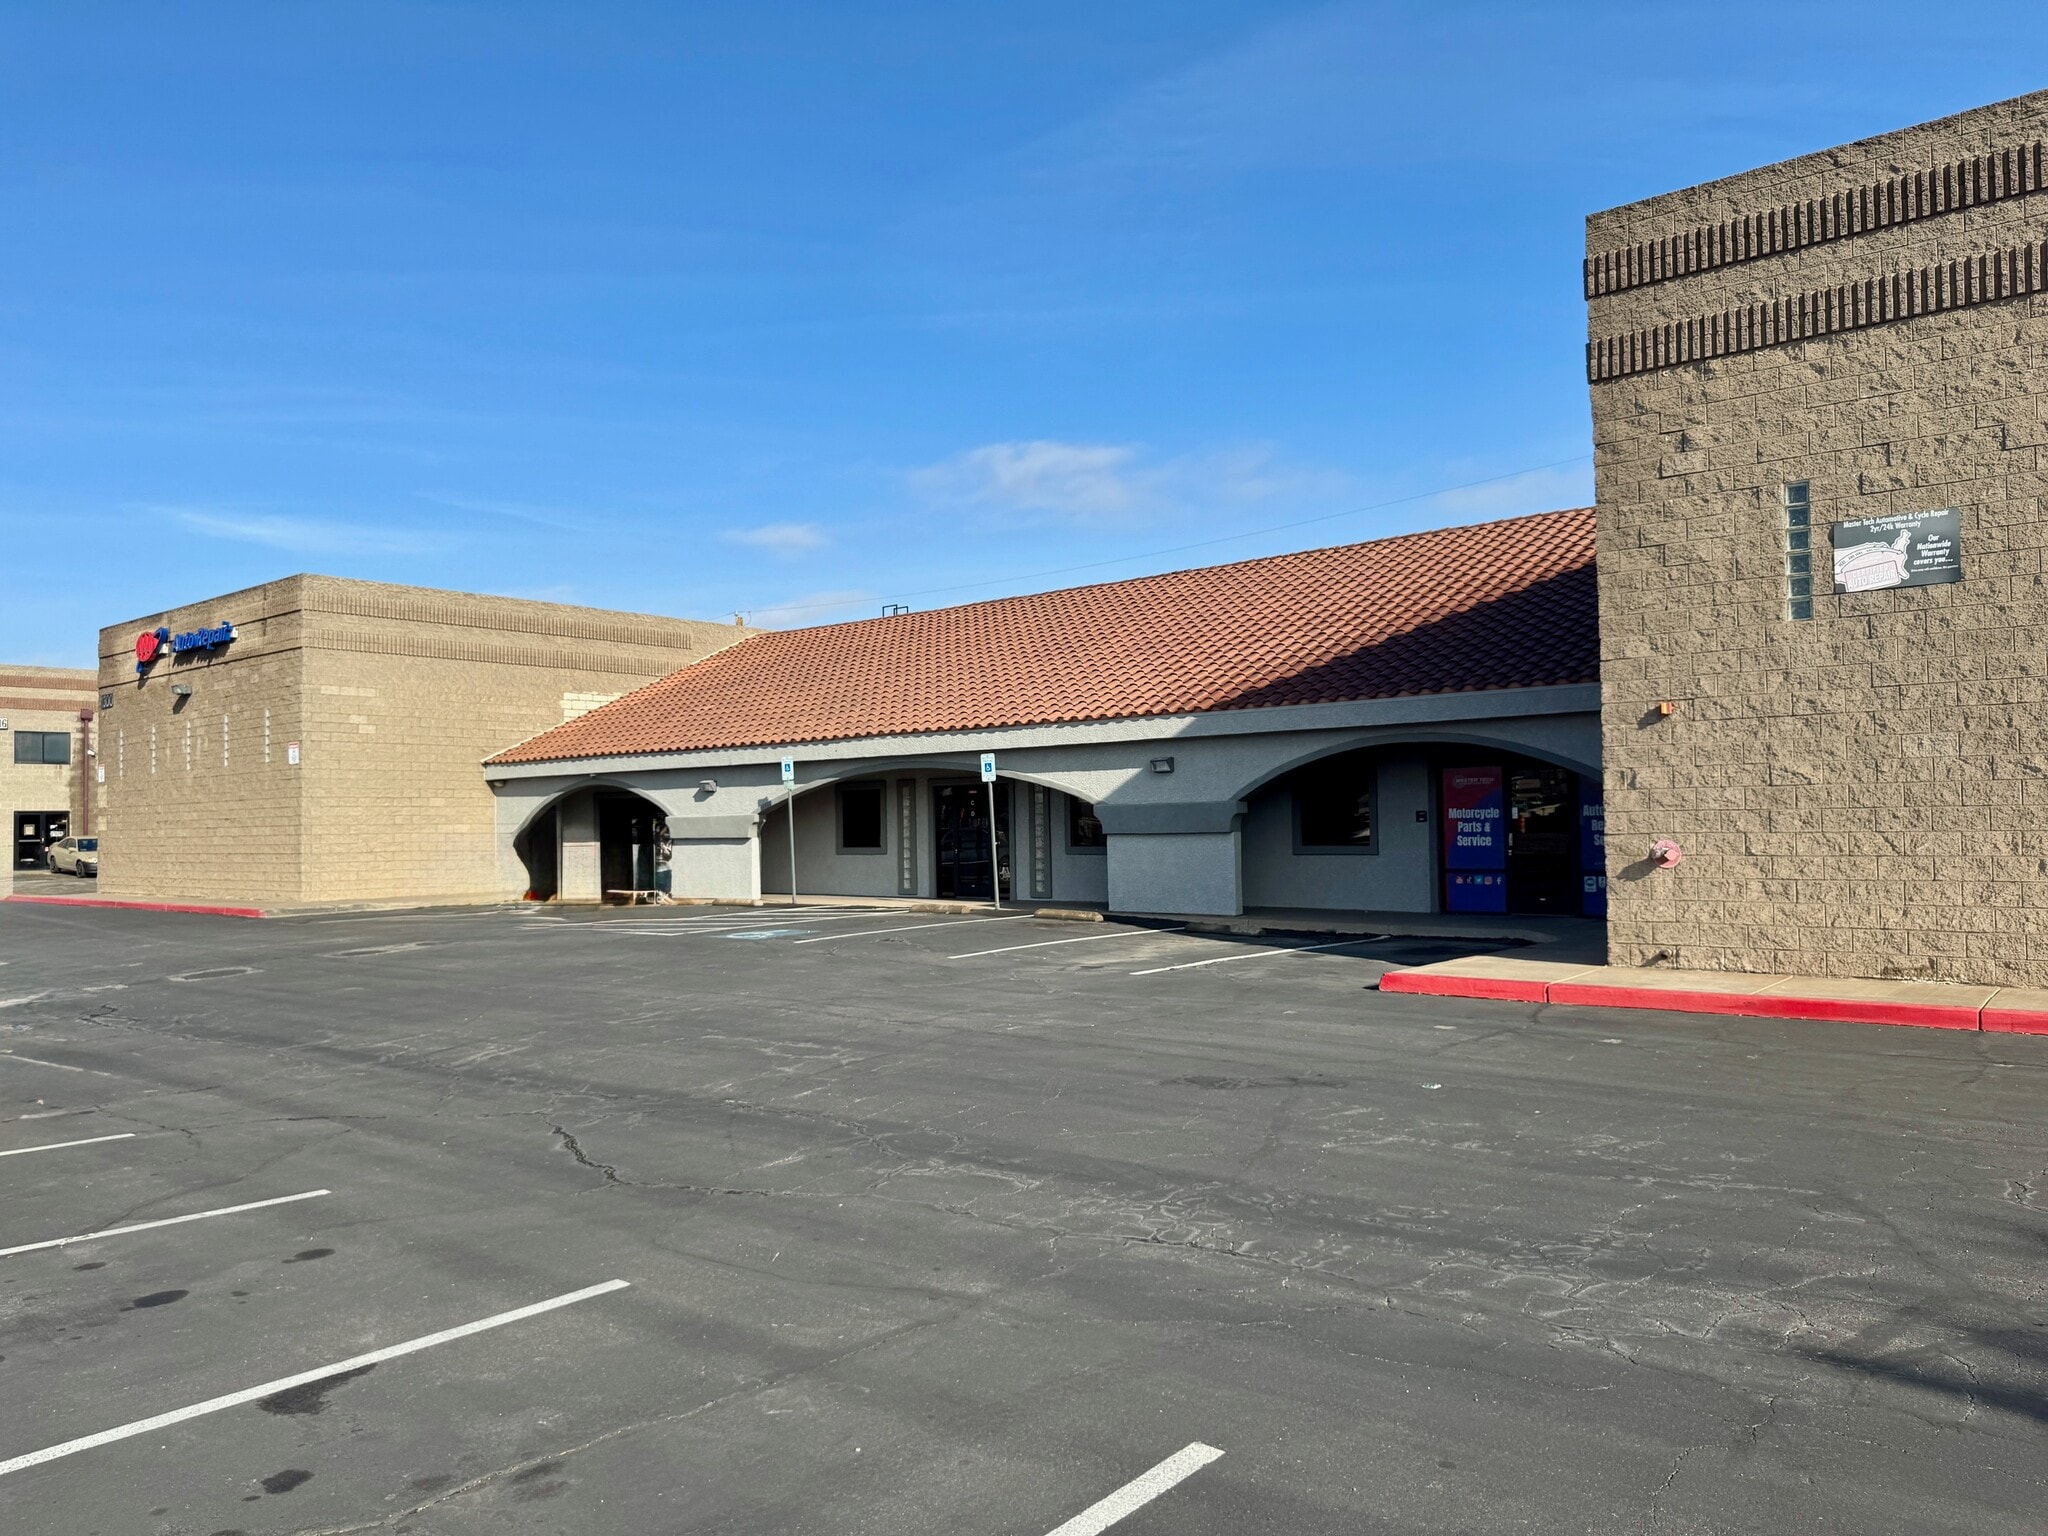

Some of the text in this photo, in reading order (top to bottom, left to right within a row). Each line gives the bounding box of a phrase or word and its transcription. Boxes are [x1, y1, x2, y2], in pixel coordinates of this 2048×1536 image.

[1862, 518, 1875, 526] Tech
[1875, 514, 1907, 524] Automotive
[1914, 511, 1929, 520] Cycle
[1930, 509, 1949, 519] Repair
[1895, 520, 1921, 530] Warranty
[1917, 539, 1951, 550] Nationwide
[1921, 548, 1950, 557] Warranty
[1870, 571, 1896, 584] REPAIR
[172, 634, 194, 652] Auto
[195, 621, 232, 650] Repair
[1448, 807, 1499, 820] Motorcycle
[1457, 821, 1491, 833] Parts &
[1457, 834, 1492, 847] Service
